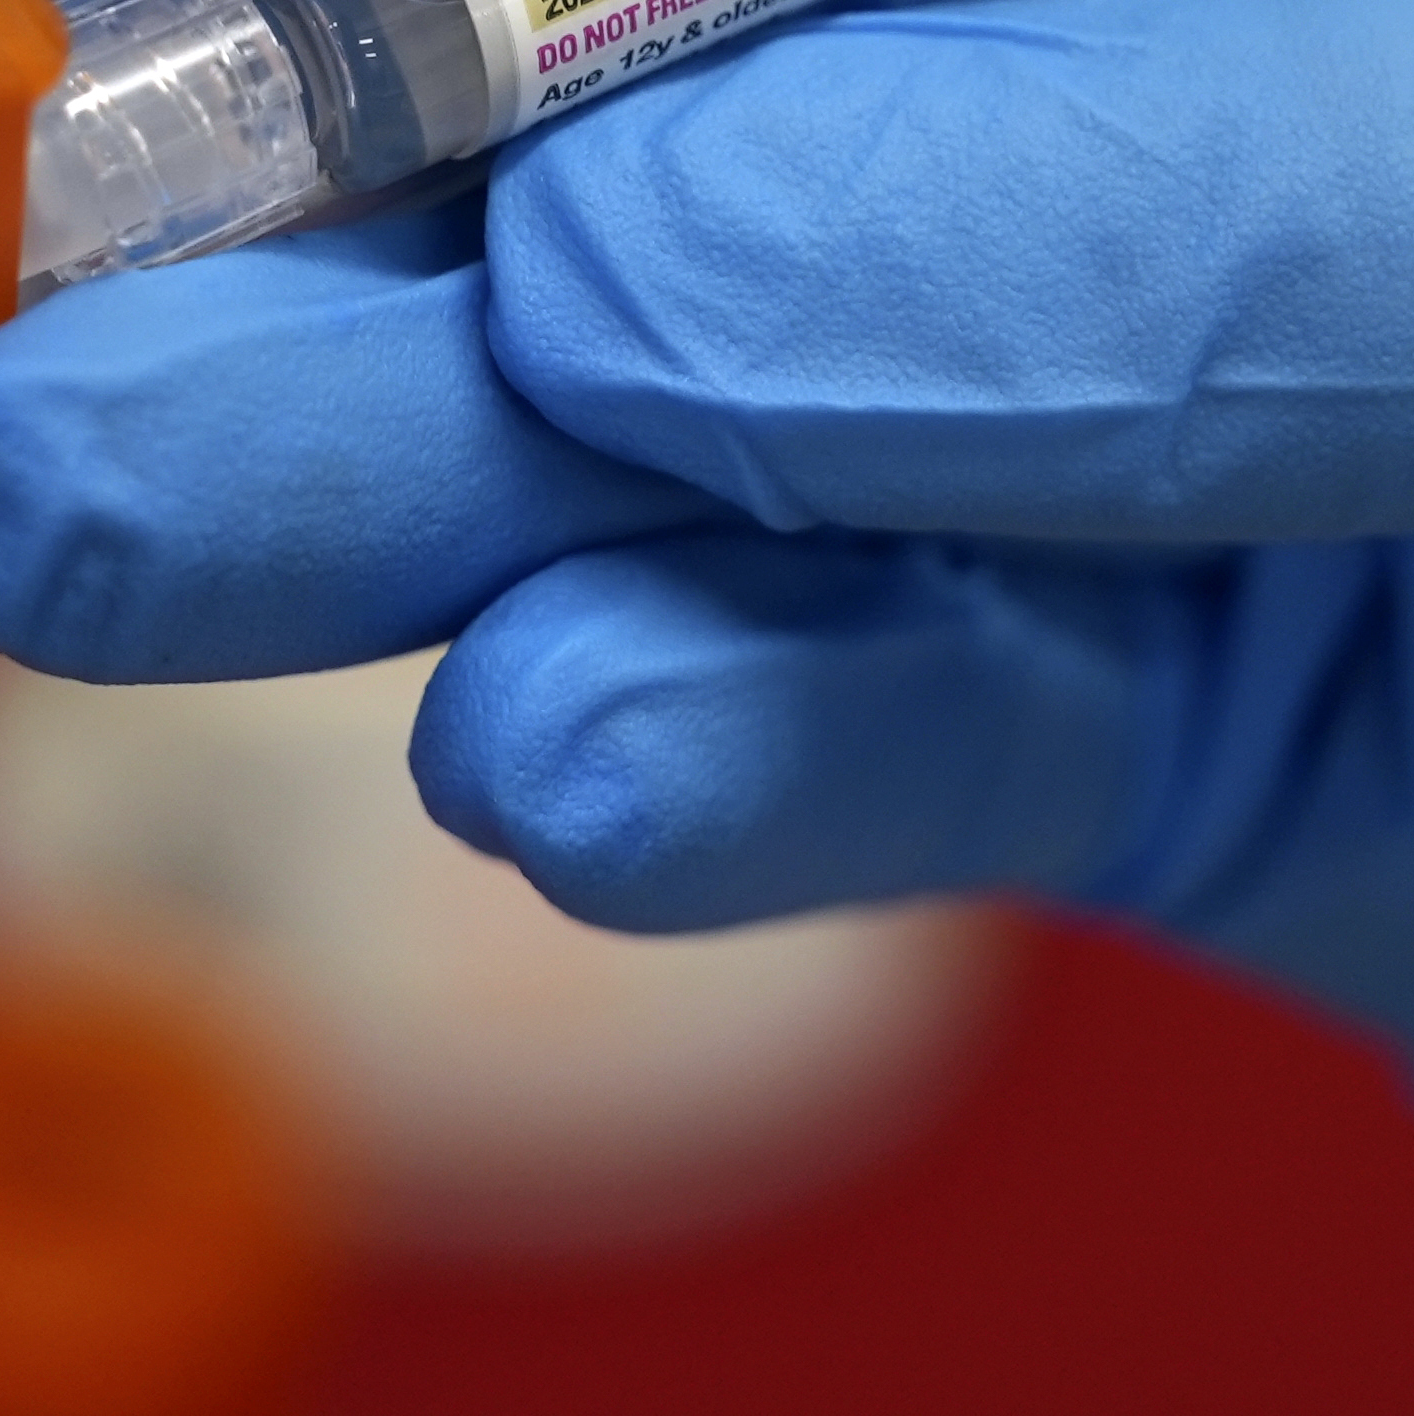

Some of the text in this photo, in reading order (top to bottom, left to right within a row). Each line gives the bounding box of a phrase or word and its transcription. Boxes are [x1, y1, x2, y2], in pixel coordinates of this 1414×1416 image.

[537, 33, 578, 74] DO
[583, 2, 640, 53] NOT
[537, 69, 604, 110] Age
[619, 36, 675, 70] 12y
[680, 19, 704, 46] &
